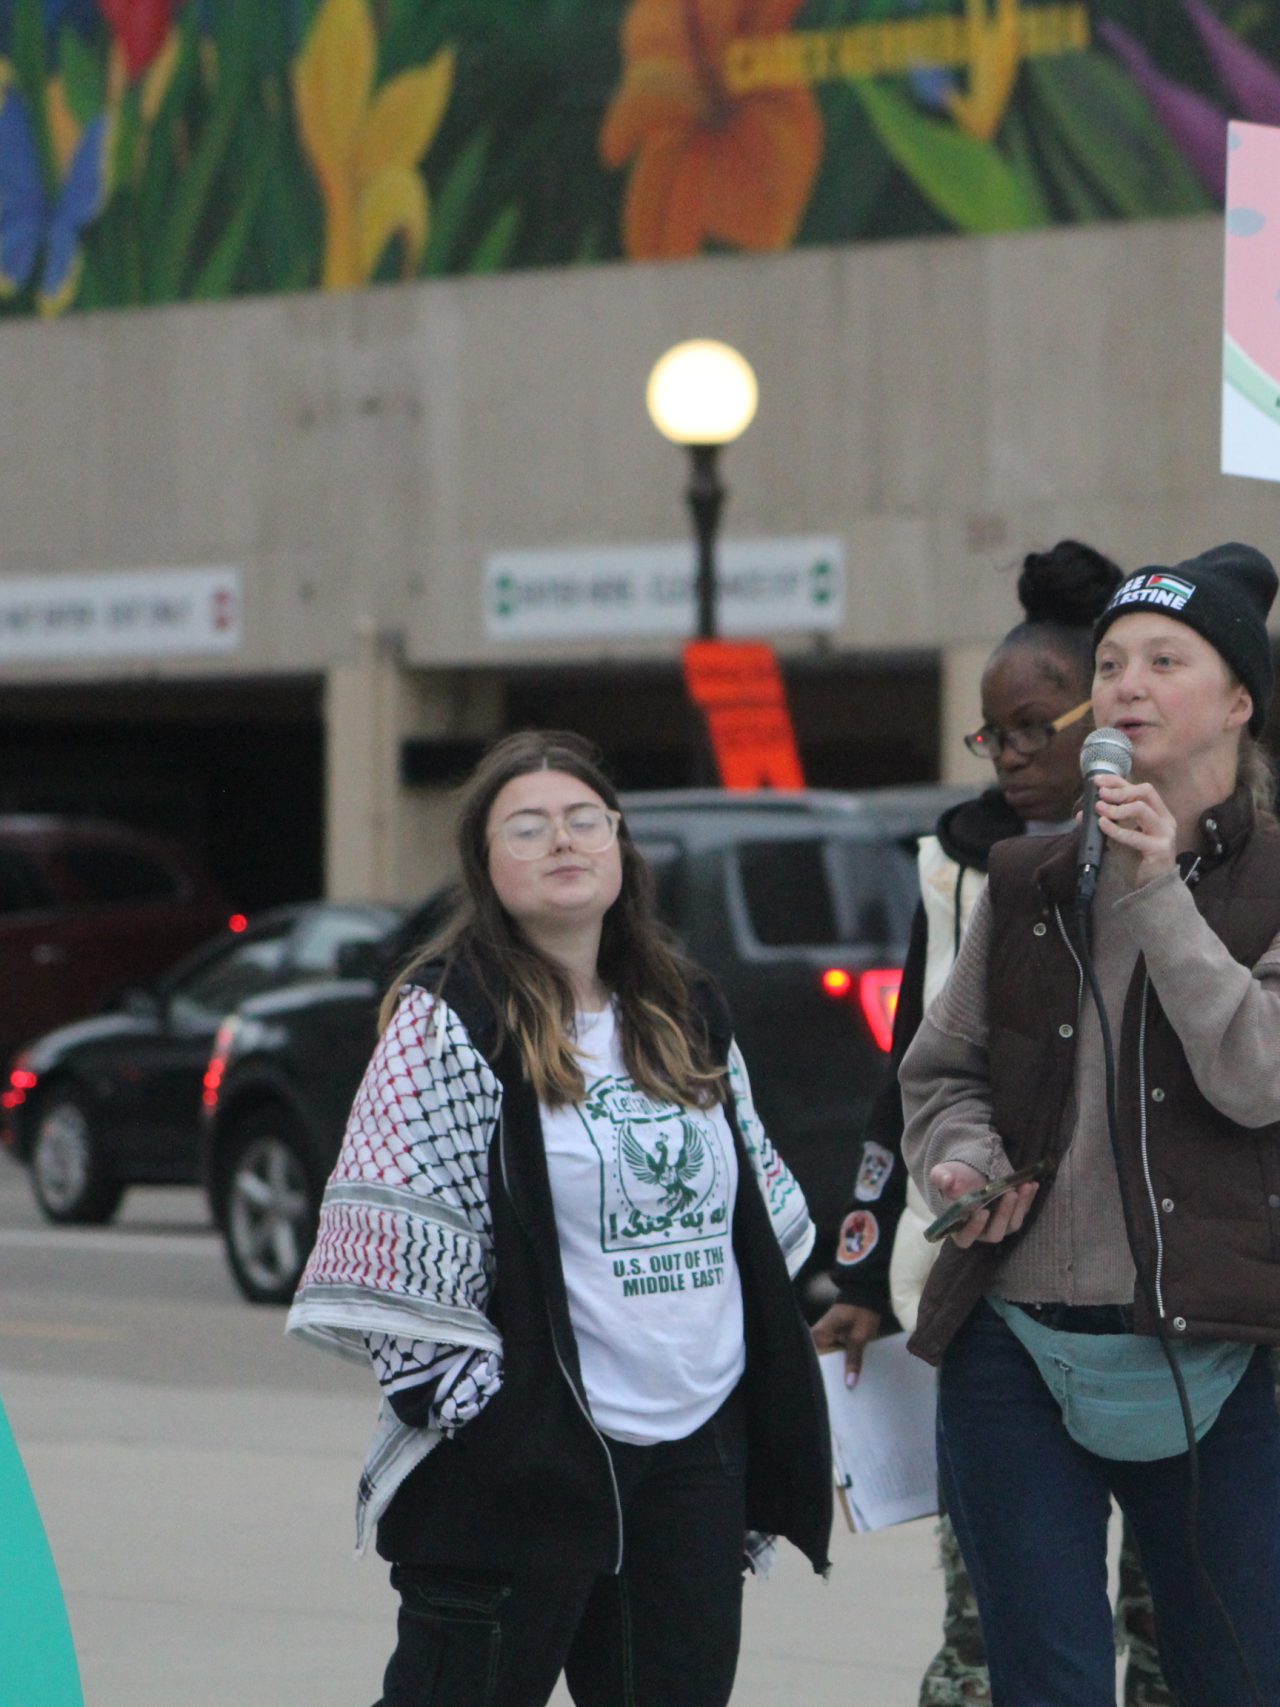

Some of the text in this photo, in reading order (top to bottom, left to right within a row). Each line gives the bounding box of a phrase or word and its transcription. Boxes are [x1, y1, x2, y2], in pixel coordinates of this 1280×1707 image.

[613, 1246, 724, 1278] U.S. OUT OF THE
[623, 1274, 685, 1297] MIDDLE
